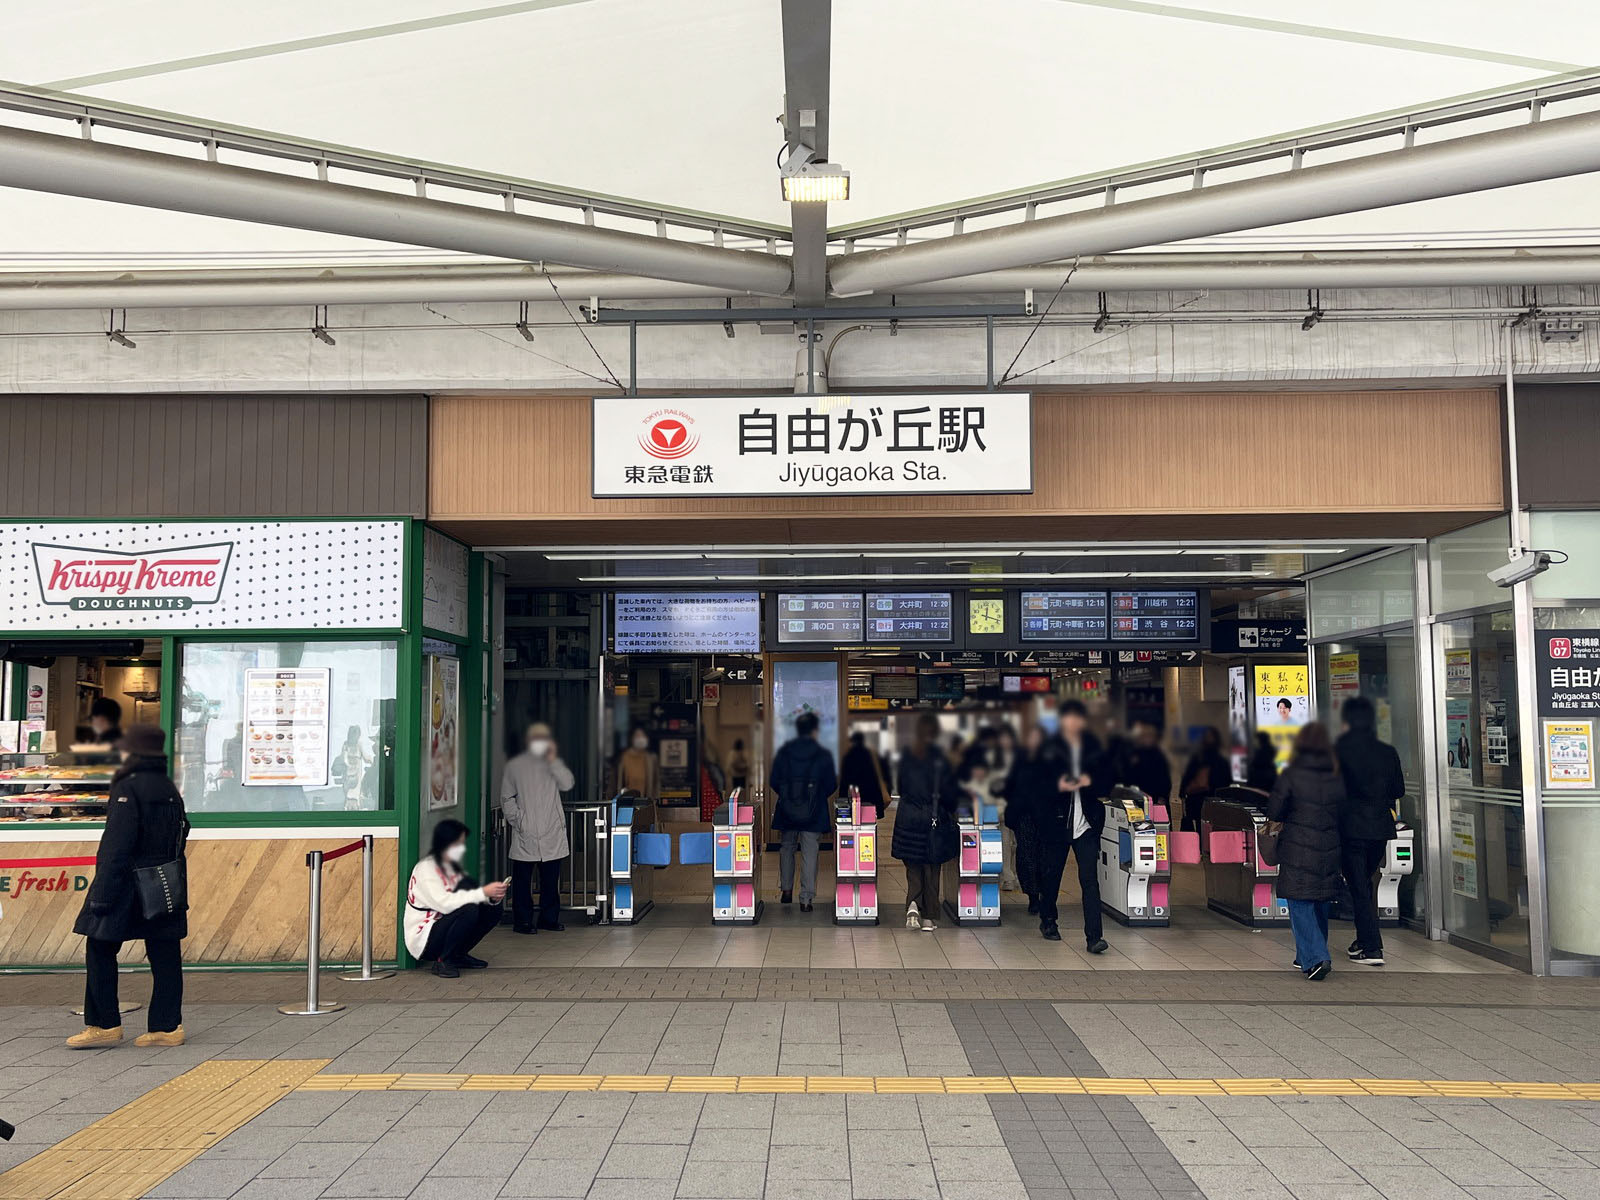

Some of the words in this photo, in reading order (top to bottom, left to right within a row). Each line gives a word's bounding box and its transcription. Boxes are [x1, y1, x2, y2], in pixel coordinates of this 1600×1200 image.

[642, 410, 663, 425] TOKYU
[664, 408, 696, 425] RAILWAYS
[738, 406, 986, 456] 自由が丘駅
[624, 464, 714, 484] 東急電鉄
[779, 462, 894, 487] Jiyūgaoka
[903, 461, 948, 481] Sta.
[48, 559, 137, 595] Krispy
[134, 558, 221, 590] Kreme
[78, 599, 184, 609] DOUGHNUTS
[1554, 648, 1567, 656] 07
[1572, 638, 1599, 646] 東横線
[1278, 672, 1288, 694] 私が
[10, 870, 70, 899] fresh
